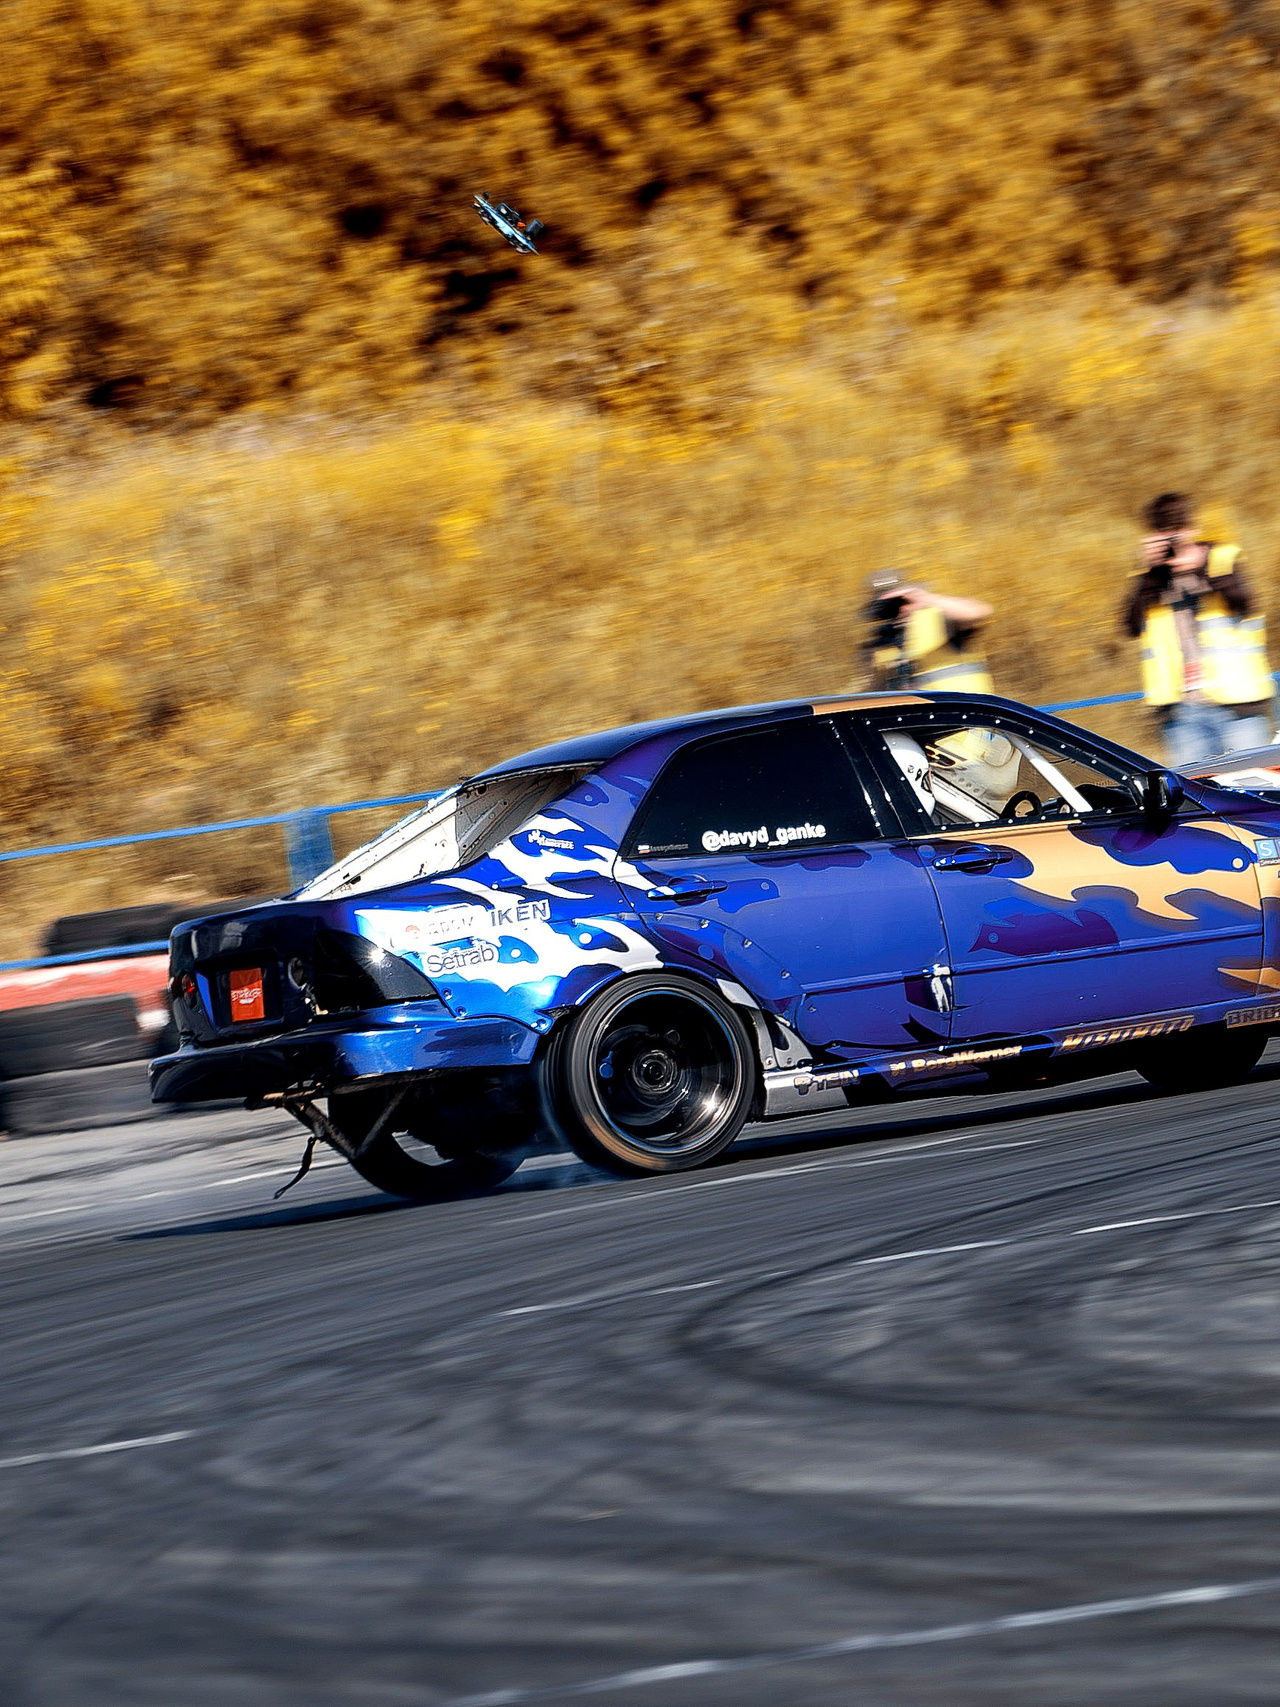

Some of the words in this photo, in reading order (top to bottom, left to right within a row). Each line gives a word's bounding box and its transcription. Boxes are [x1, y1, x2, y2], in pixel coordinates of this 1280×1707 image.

[701, 822, 826, 852] @davyd_ganke
[427, 944, 495, 973] Setrab
[911, 1045, 1023, 1073] BorgWarner
